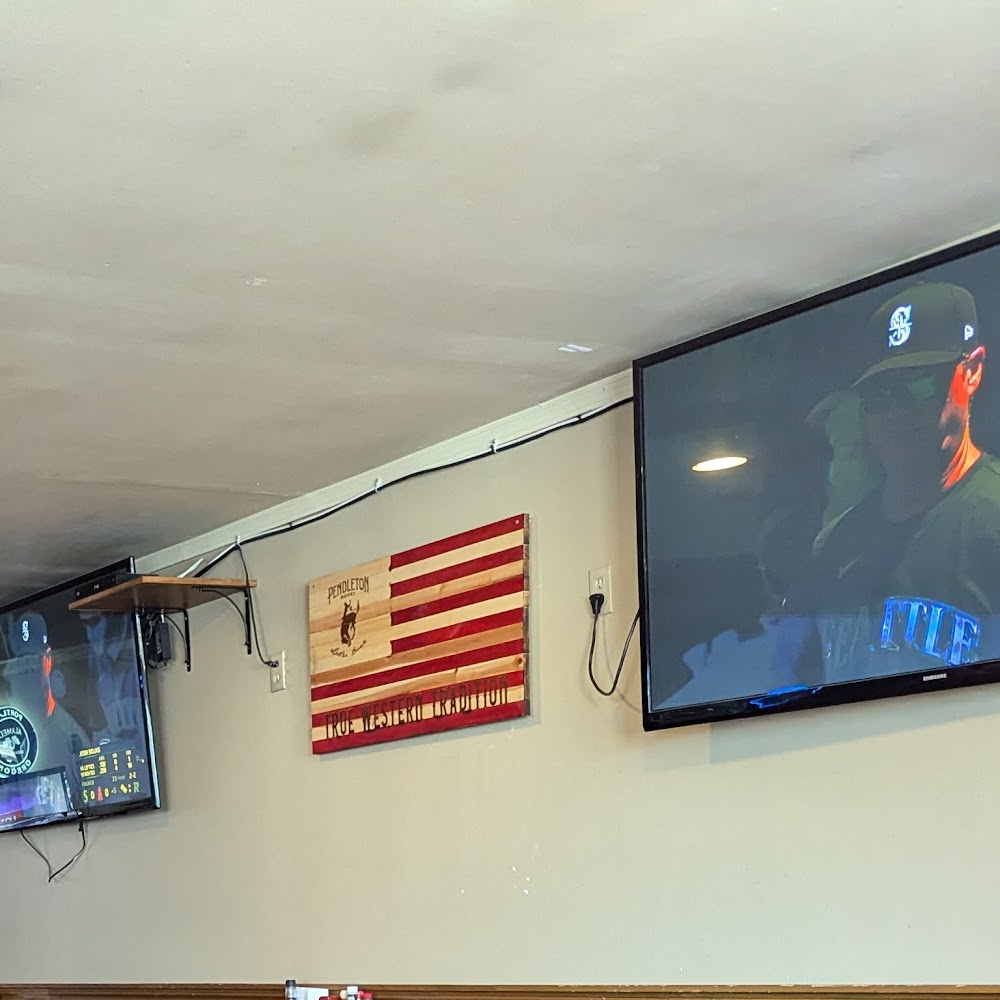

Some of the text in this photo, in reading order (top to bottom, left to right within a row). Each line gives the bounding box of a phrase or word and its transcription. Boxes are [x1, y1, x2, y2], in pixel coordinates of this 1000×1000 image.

[328, 576, 369, 604] PENDLETON
[324, 676, 509, 739] TRUE WESTERN TRADITION
[90, 791, 95, 799] 0
[104, 788, 109, 797] 0
